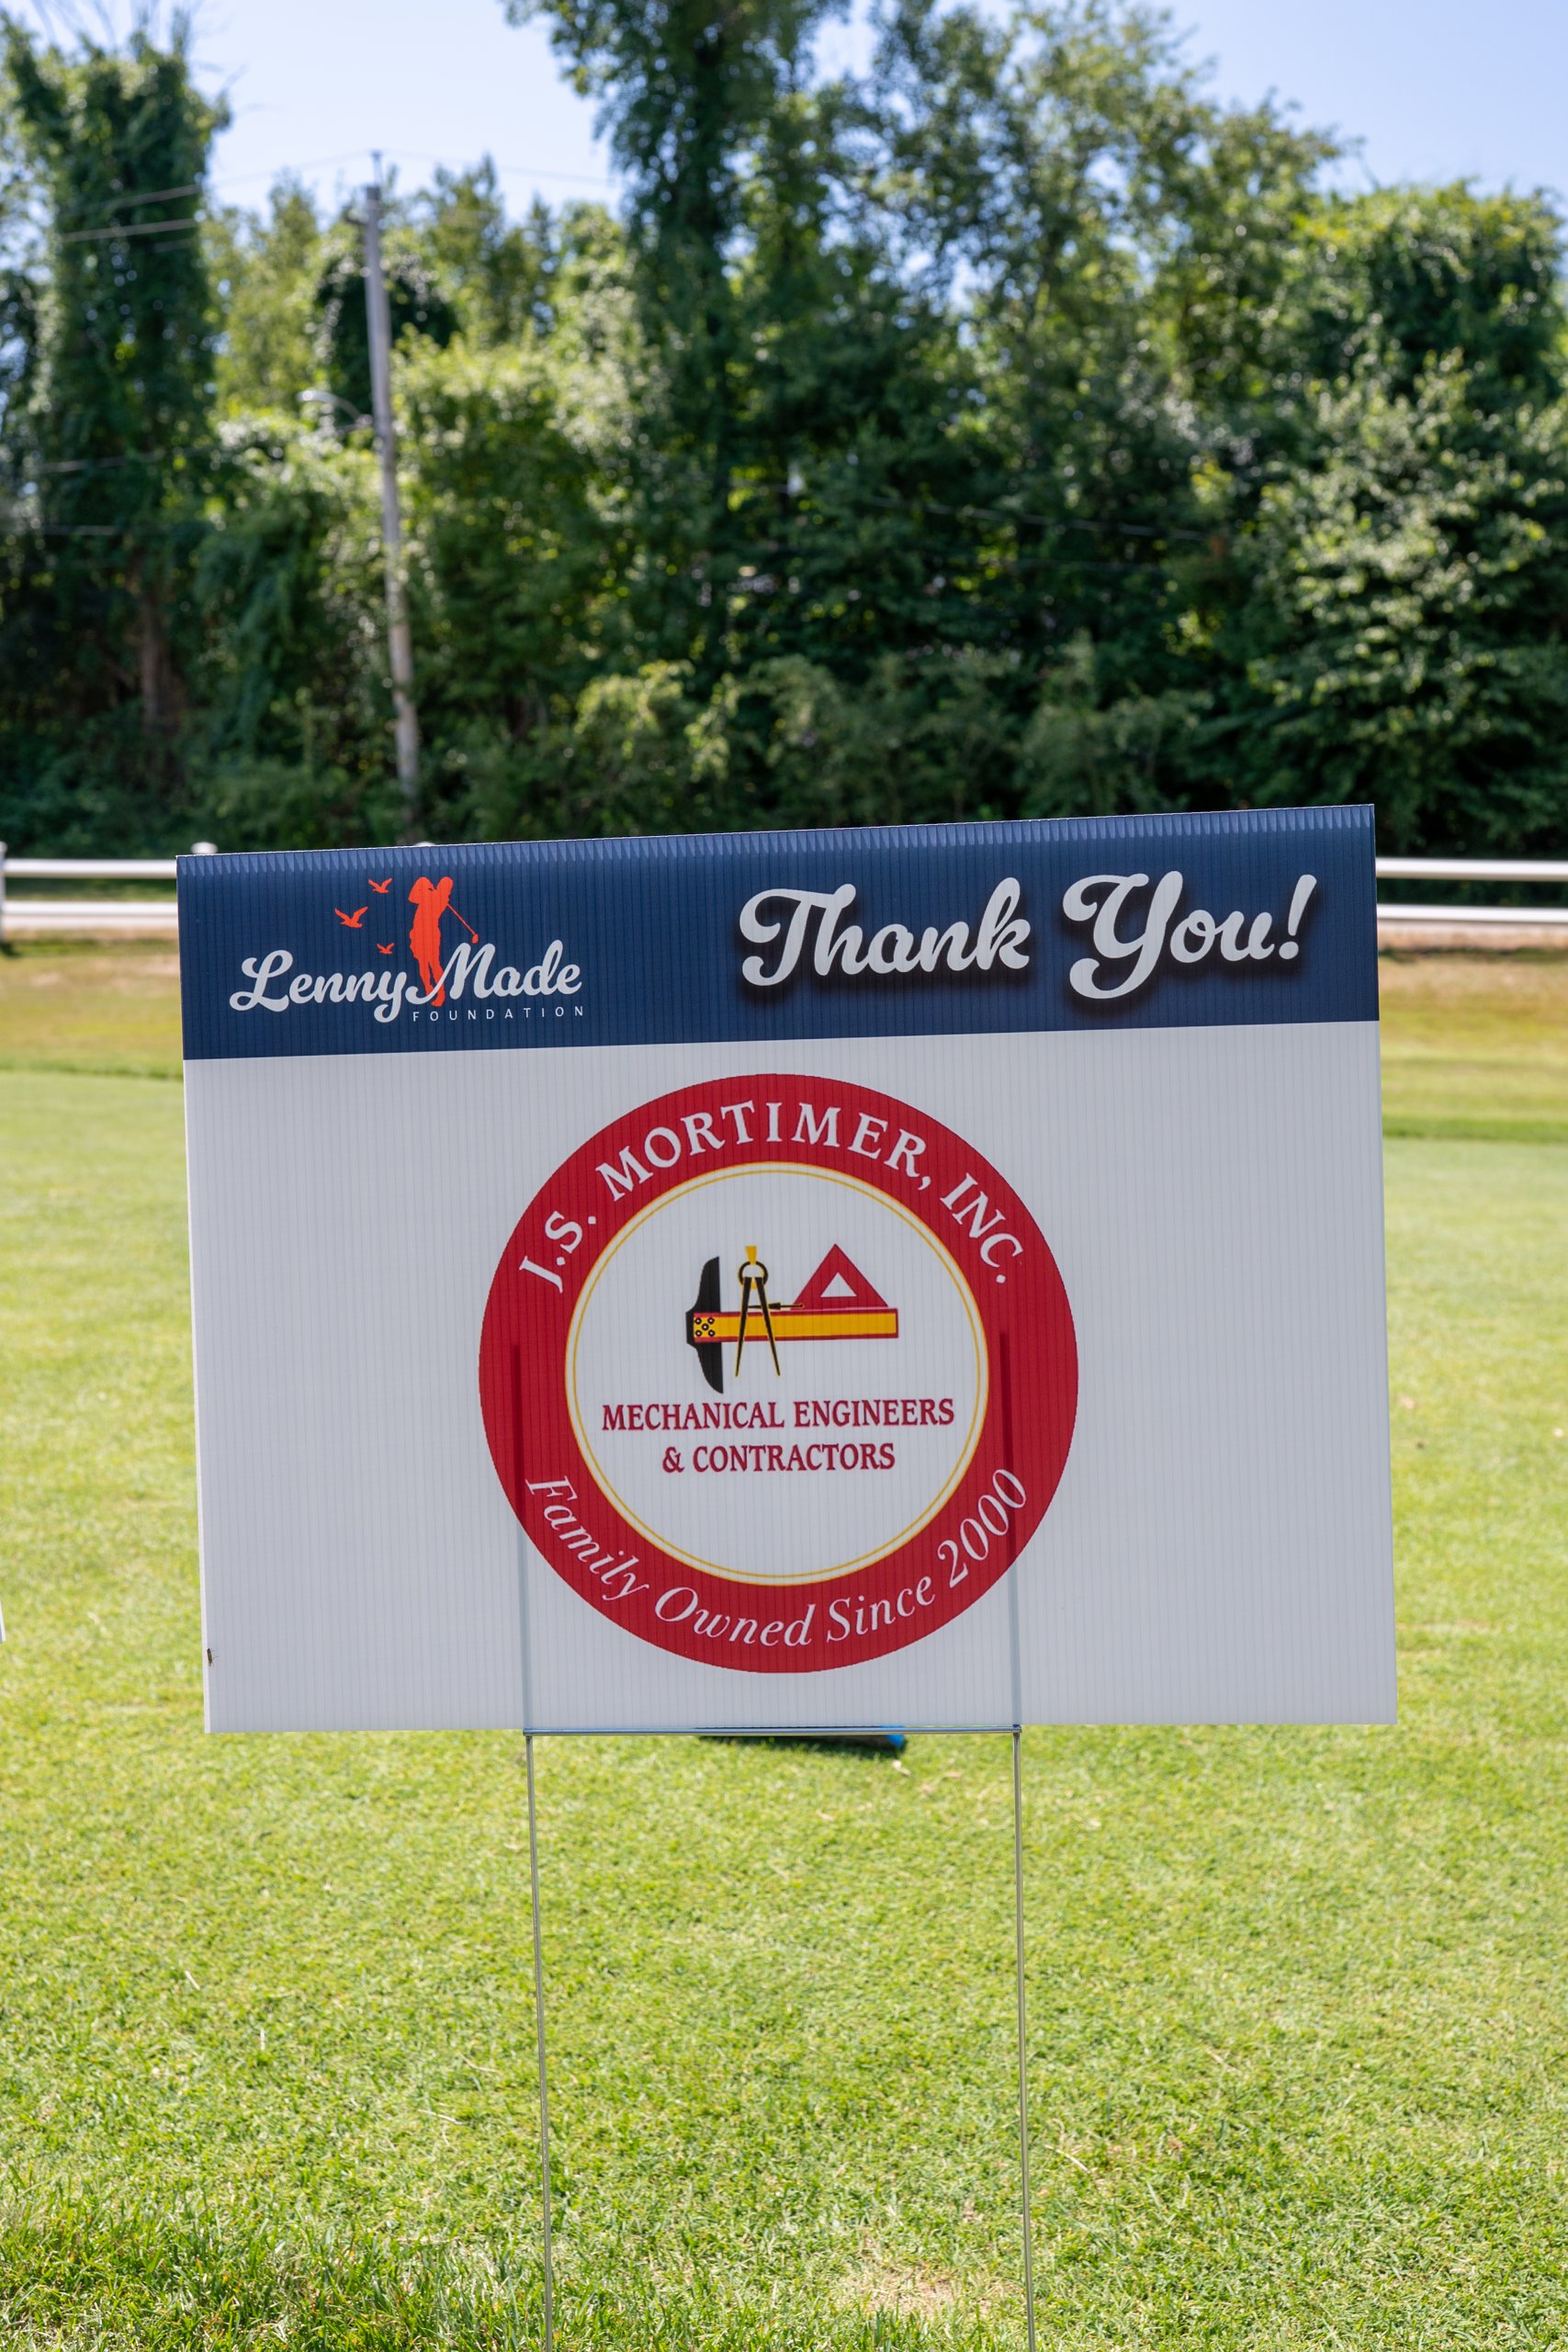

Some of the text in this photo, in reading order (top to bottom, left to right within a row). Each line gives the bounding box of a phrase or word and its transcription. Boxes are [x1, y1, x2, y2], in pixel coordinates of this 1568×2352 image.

[739, 870, 1318, 1000] Thank You!
[230, 939, 583, 1023] Lenny Made
[412, 1005, 584, 1023] FOUNDATION
[519, 1099, 1024, 1294] J.S. MORTIMER, INC.
[601, 1396, 956, 1432] MECHANICAL ENGINEERS
[661, 1442, 896, 1474] & CONTRACTORS
[525, 1468, 1028, 1647] Family Owned Since 2000
